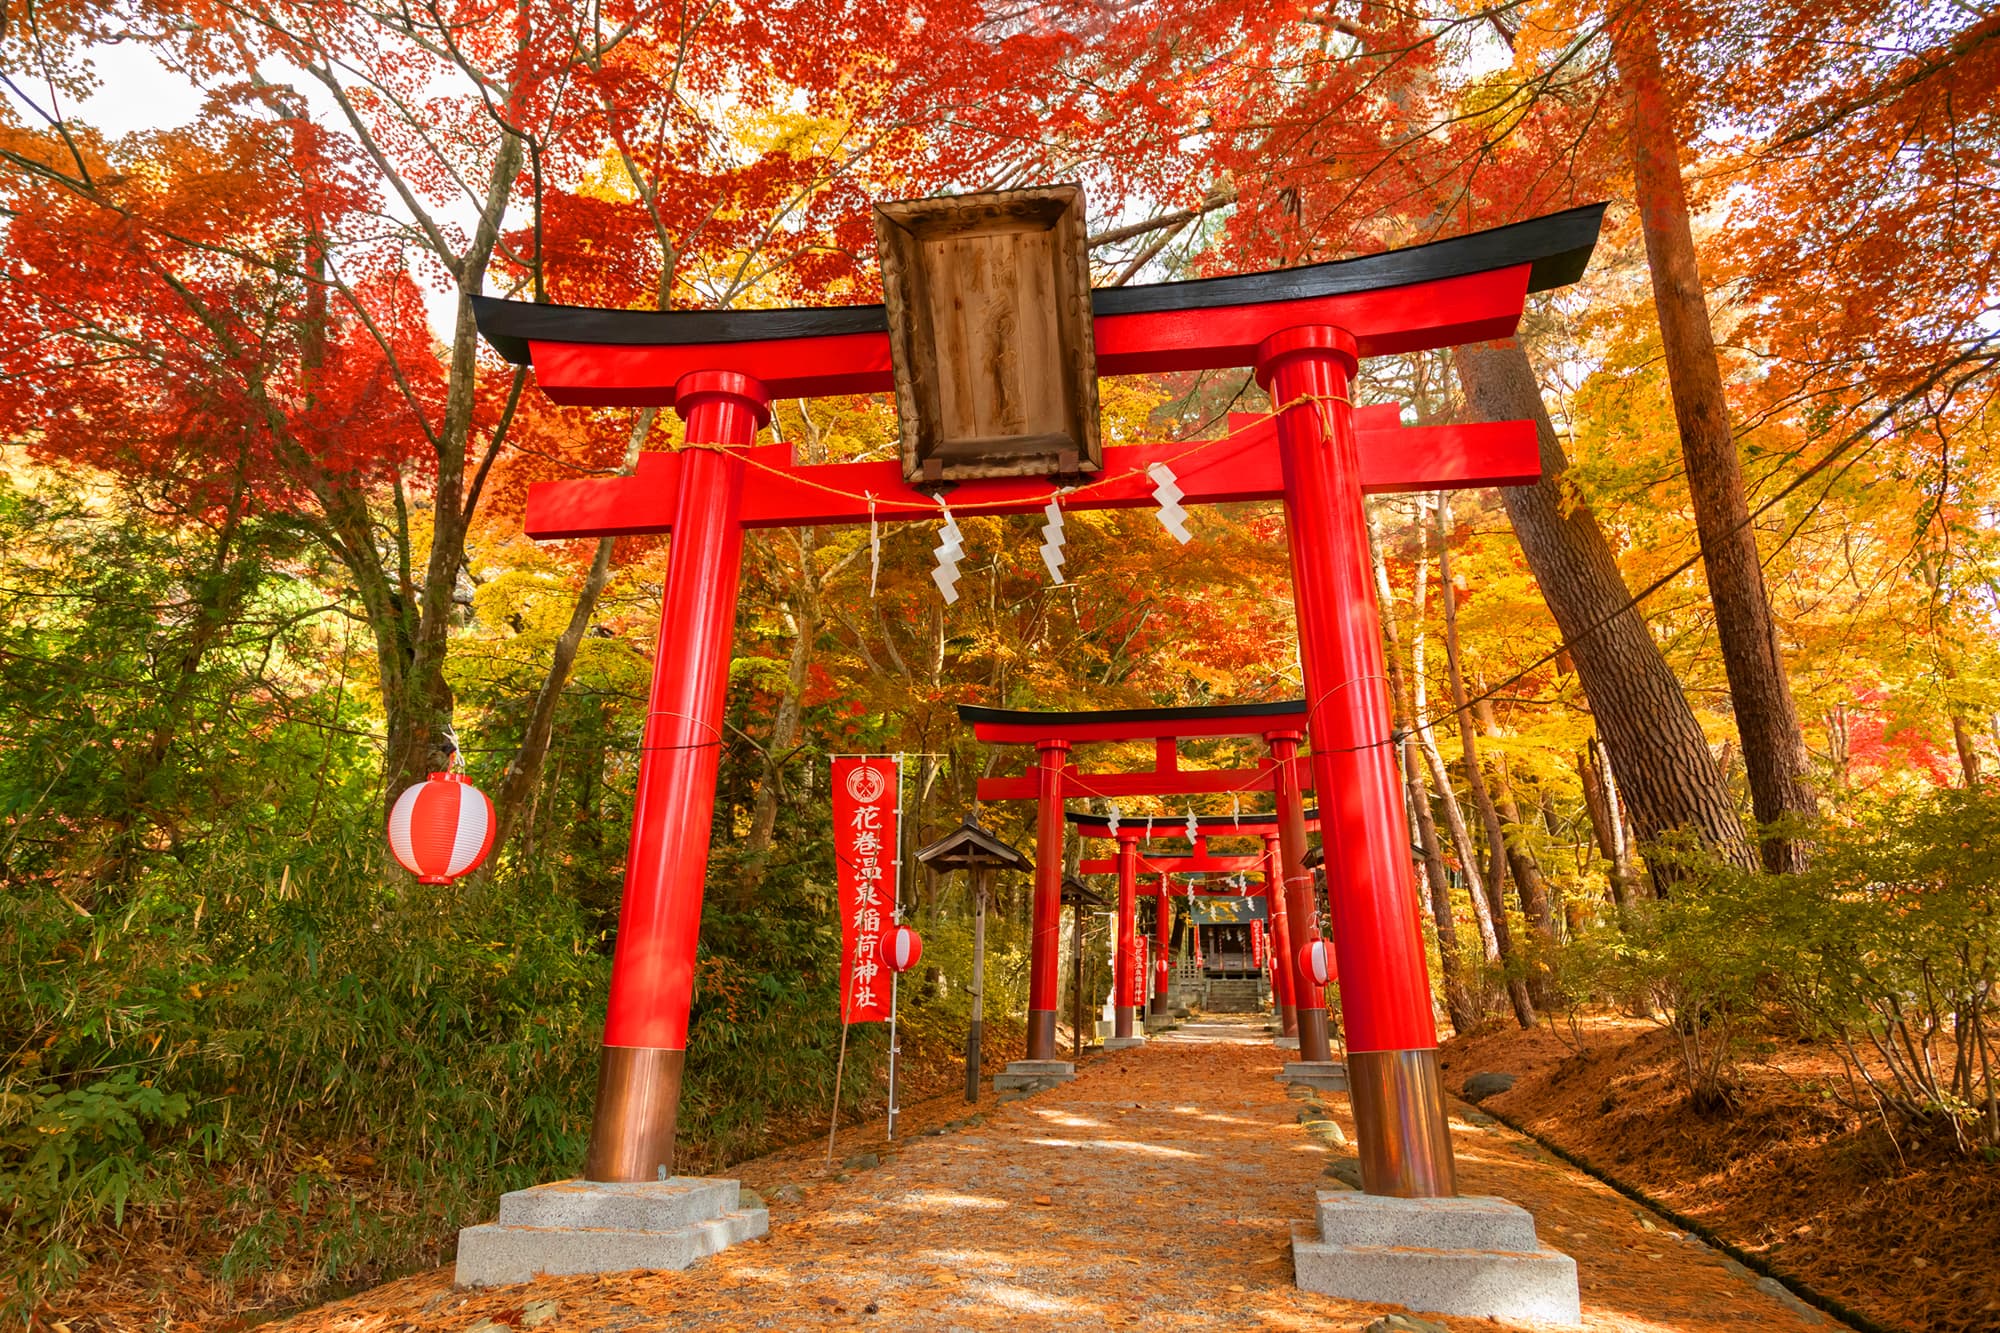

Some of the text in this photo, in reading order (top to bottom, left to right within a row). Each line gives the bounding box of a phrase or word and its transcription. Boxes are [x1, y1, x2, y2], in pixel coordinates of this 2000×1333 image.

[851, 805, 883, 1009] 花巻温泉稲荷神社
